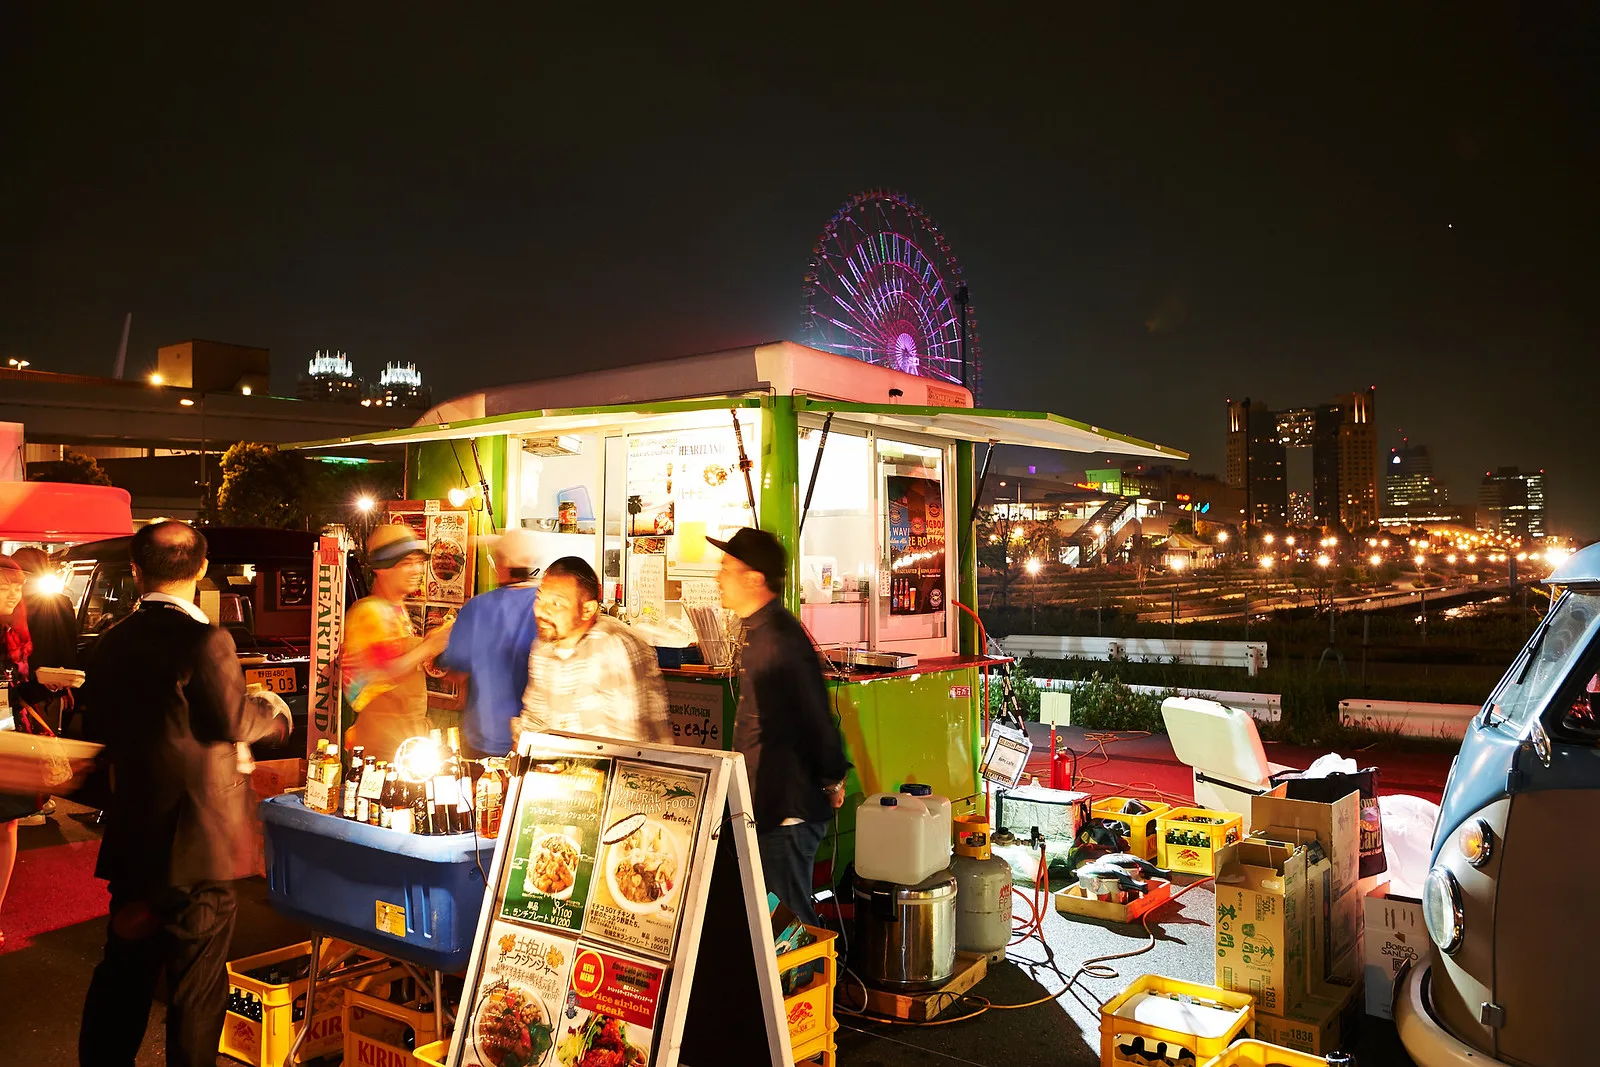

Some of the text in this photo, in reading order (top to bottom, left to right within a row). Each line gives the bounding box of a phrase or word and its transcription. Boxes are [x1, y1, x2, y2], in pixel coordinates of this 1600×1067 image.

[315, 564, 331, 732] HEARTLAND
[684, 719, 718, 744] cafe
[615, 793, 661, 814] HAWAIIAN
[666, 798, 695, 811] FOOD
[618, 785, 660, 803] NATURAL
[527, 901, 539, 911] 単品
[513, 908, 571, 928] ランチプレート ¥1200
[1217, 902, 1237, 948] 茶の間
[515, 937, 548, 959] 土佐山
[614, 997, 650, 1015] sirloin
[1266, 986, 1276, 1008] 1838
[596, 1003, 625, 1017] steak
[1290, 1028, 1313, 1043] 1838
[358, 1040, 407, 1067] KIRIN
